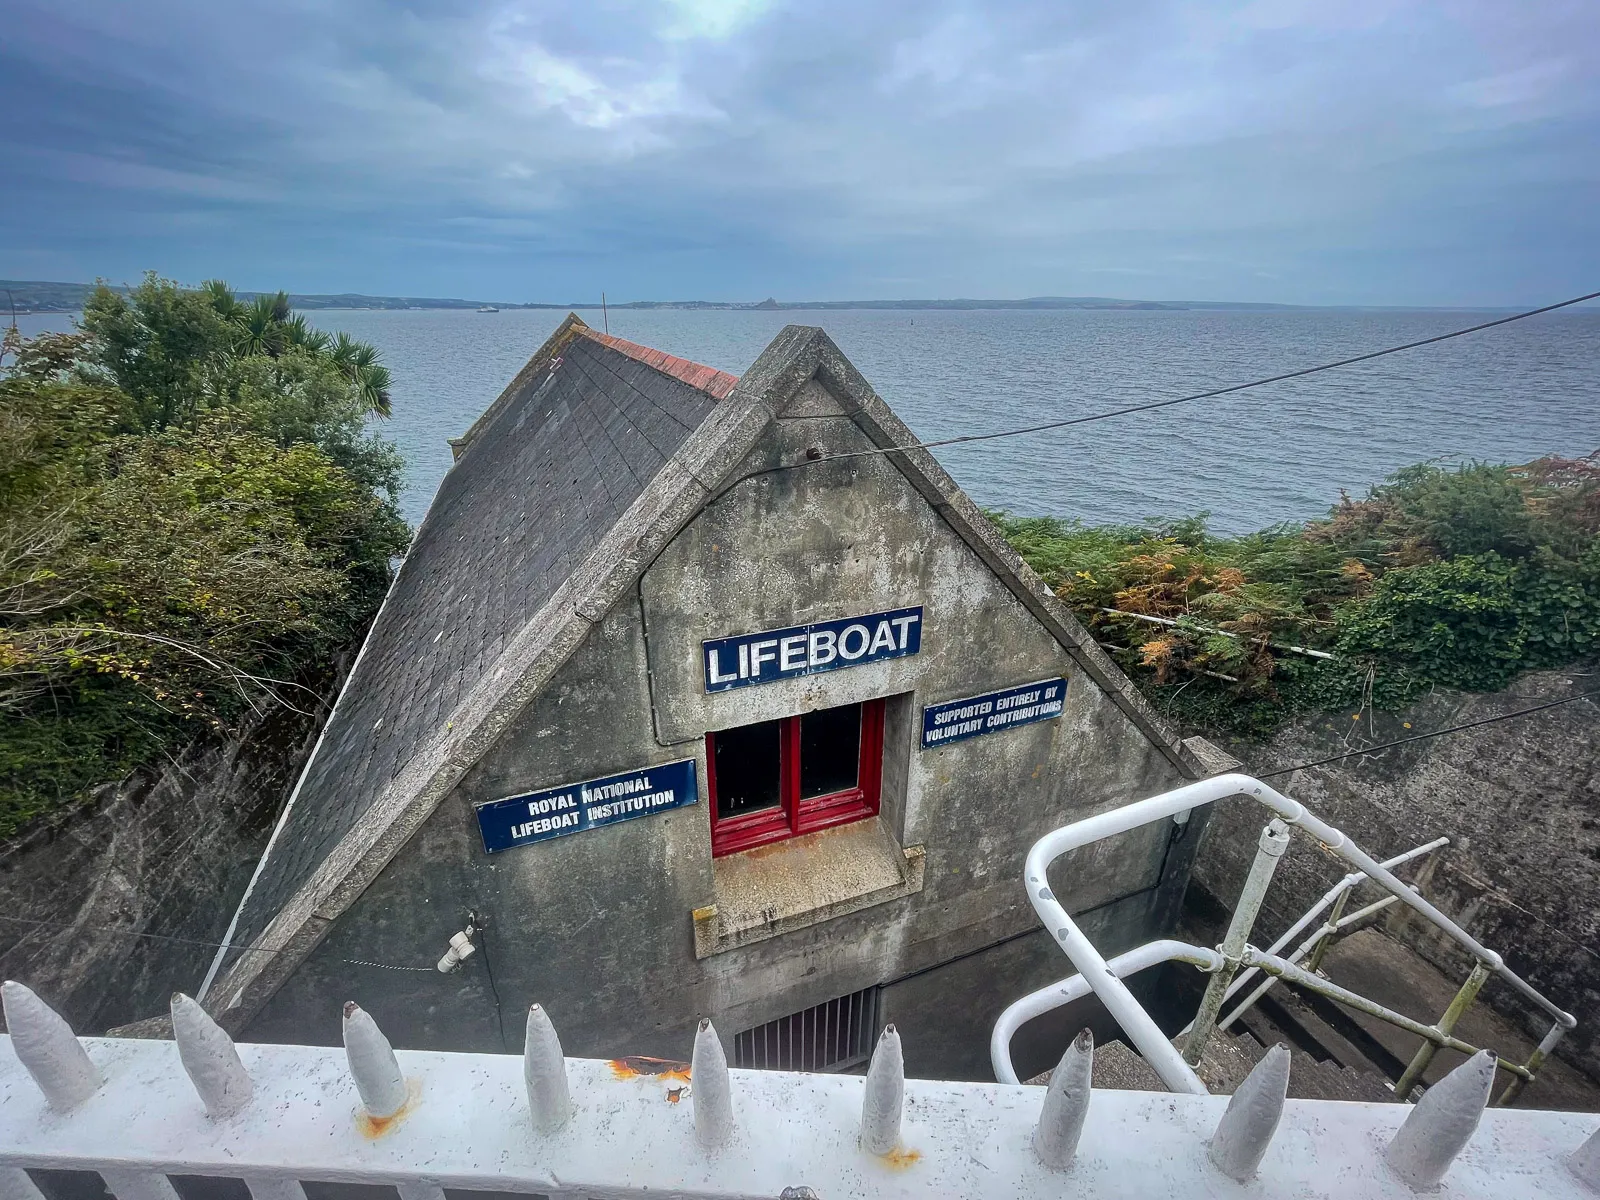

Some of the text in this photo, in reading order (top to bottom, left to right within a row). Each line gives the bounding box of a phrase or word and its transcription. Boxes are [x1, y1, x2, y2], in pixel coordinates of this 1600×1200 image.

[709, 615, 919, 684] LIFEBOAT
[926, 700, 1062, 742] VOLUNTARY CONTRIBUTIONS
[934, 686, 1058, 725] SUPPORTED ENTIRELY BY
[510, 790, 675, 839] LIFEBOAT INSTITUTION
[528, 777, 653, 816] ROYAL NATIONAL
